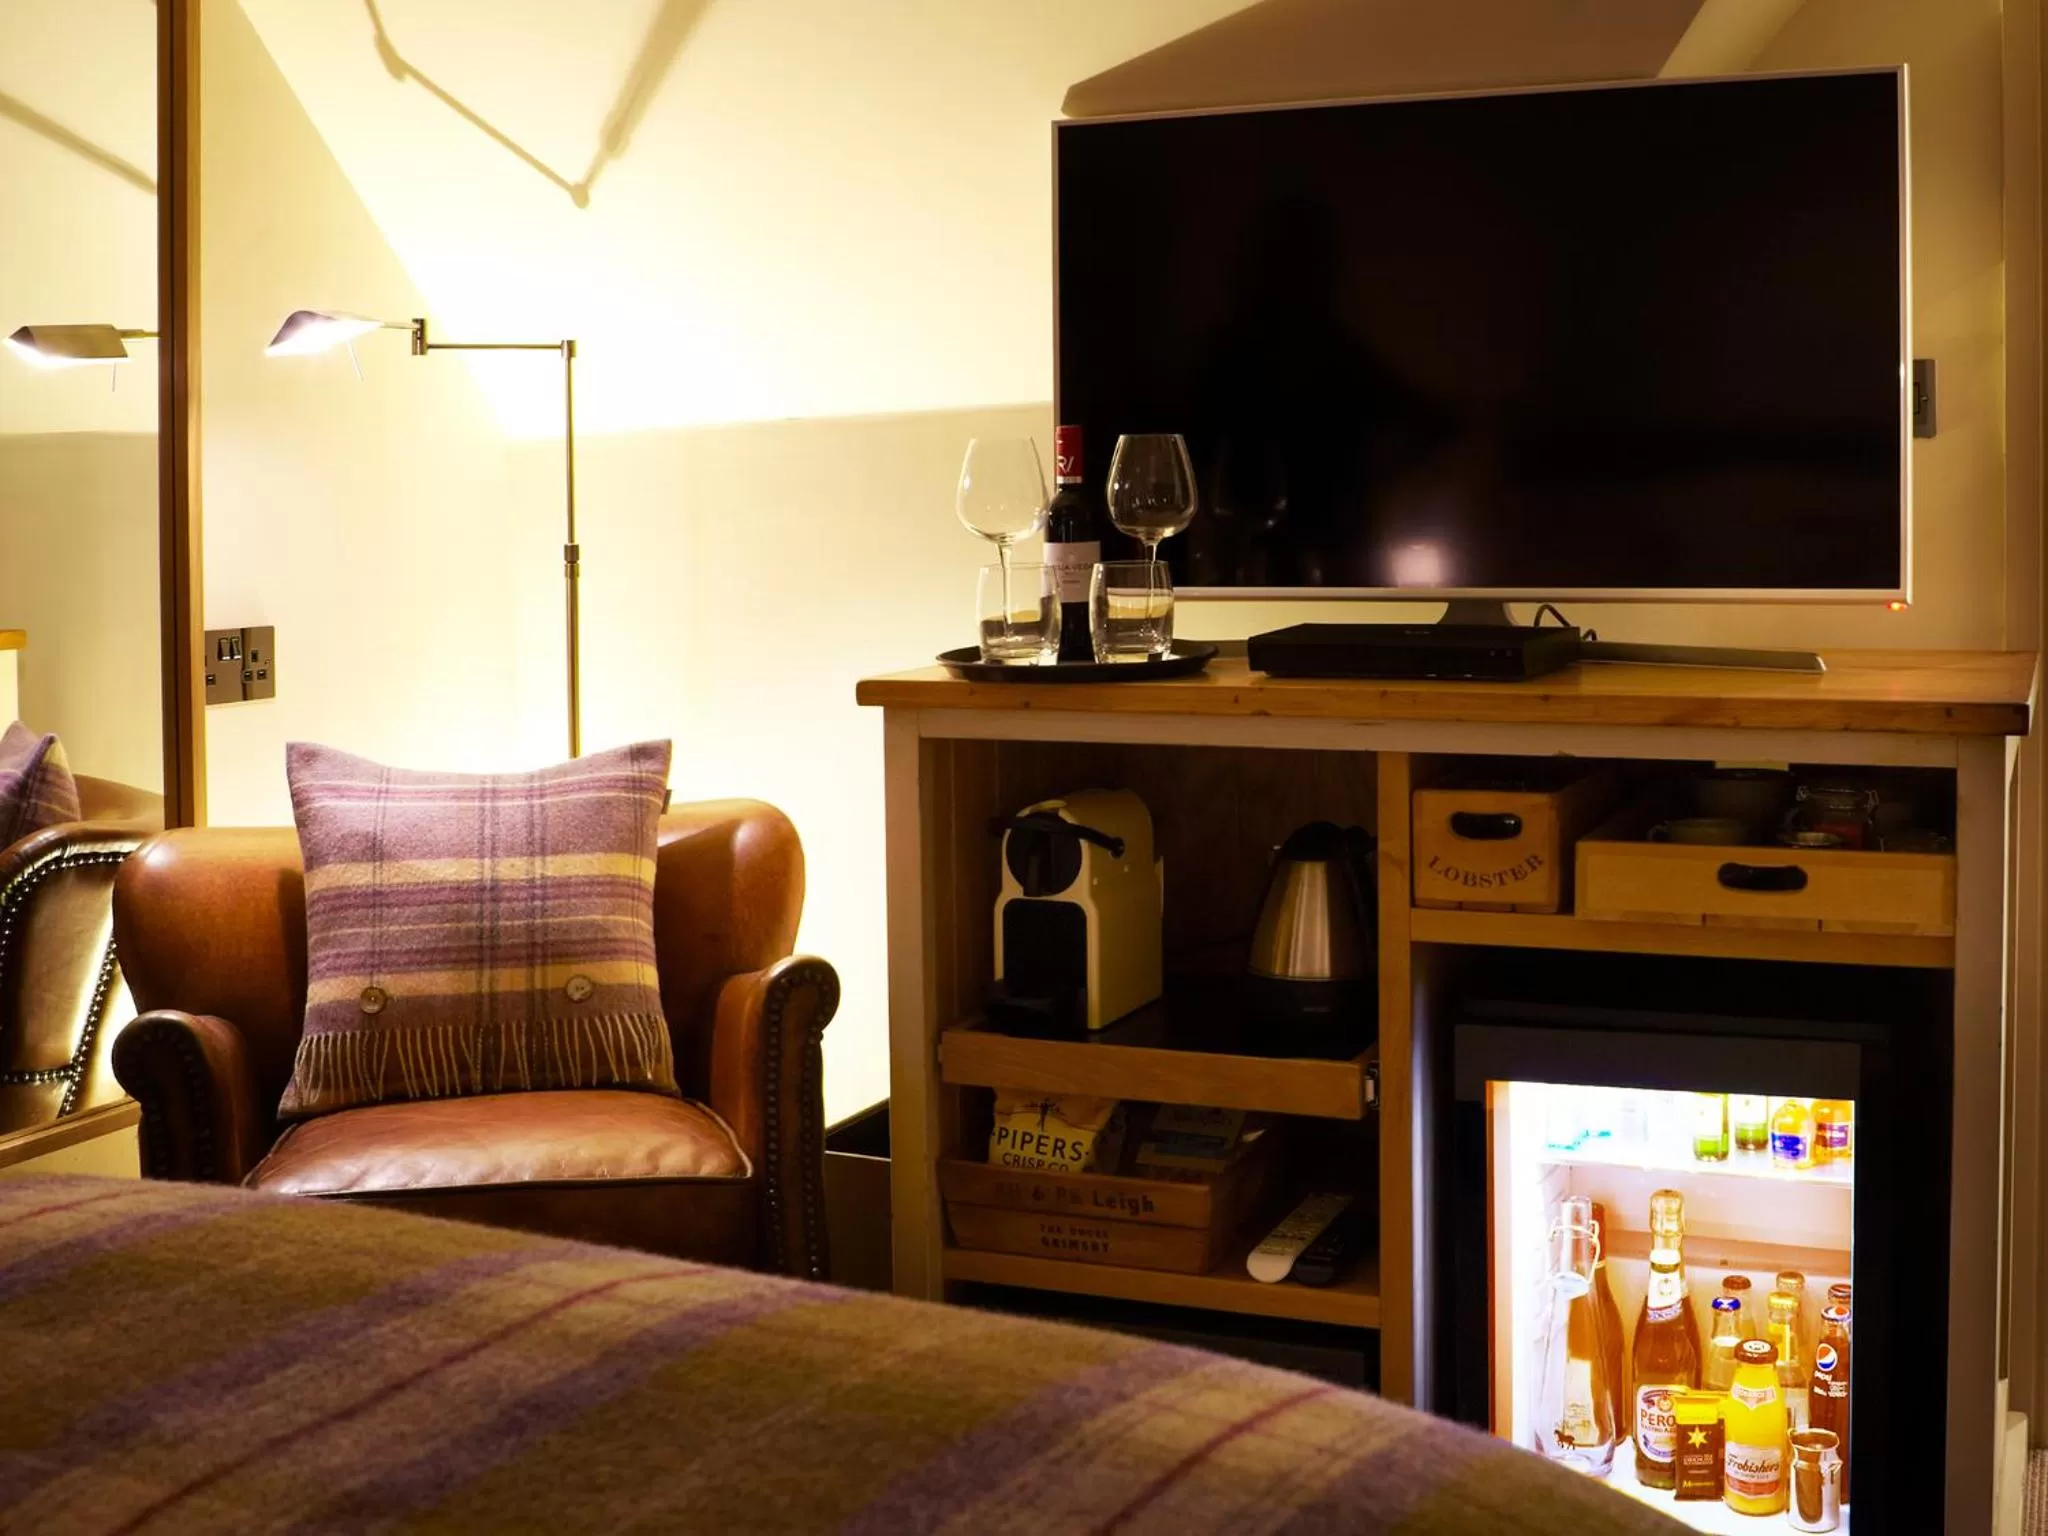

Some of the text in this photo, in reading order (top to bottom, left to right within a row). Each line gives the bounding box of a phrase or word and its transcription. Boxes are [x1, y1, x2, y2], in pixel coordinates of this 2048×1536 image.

[1428, 854, 1546, 888] LOBSTER
[997, 1126, 1084, 1162] PIPERS
[1002, 1152, 1046, 1169] CRISP
[1092, 1188, 1155, 1218] Leigh
[1040, 1235, 1110, 1253] GRIMSBY
